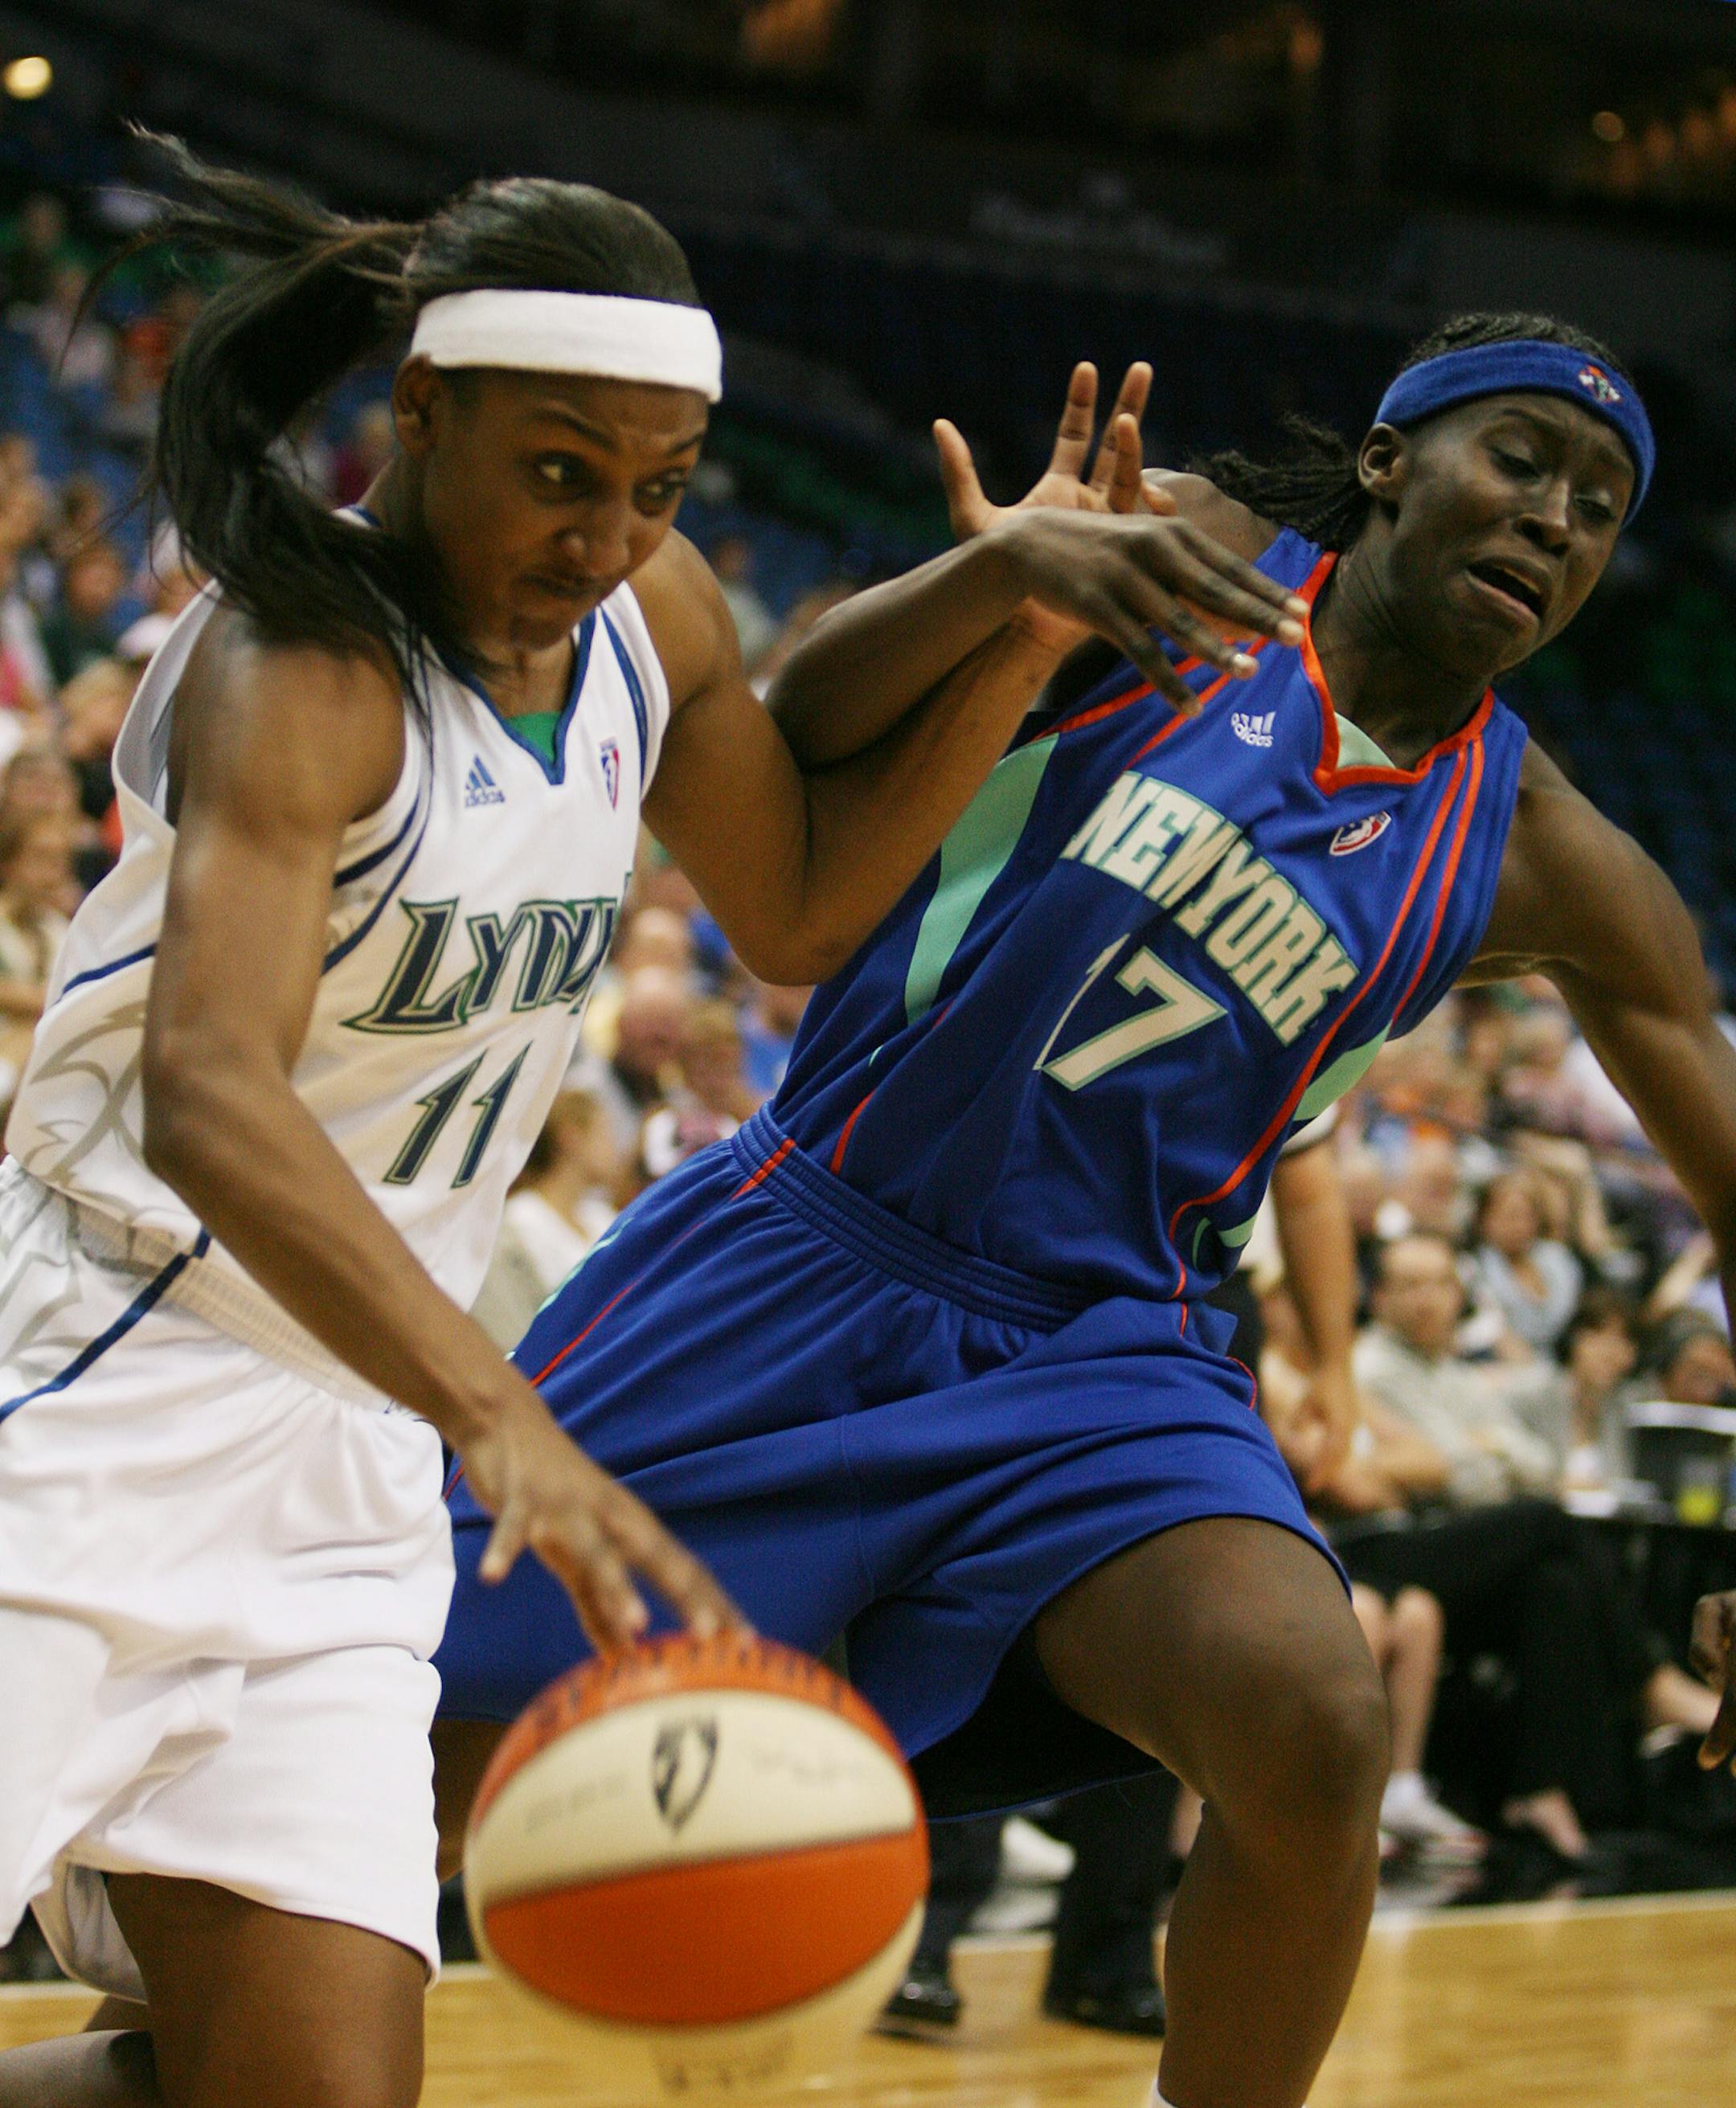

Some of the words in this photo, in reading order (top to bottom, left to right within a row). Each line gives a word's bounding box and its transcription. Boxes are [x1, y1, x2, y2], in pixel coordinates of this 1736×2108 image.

[1231, 712, 1274, 748] adidas
[340, 876, 633, 1034] LYN
[1058, 769, 1243, 910] NEW
[1173, 836, 1360, 1047] YORK
[383, 1040, 534, 1189] 11
